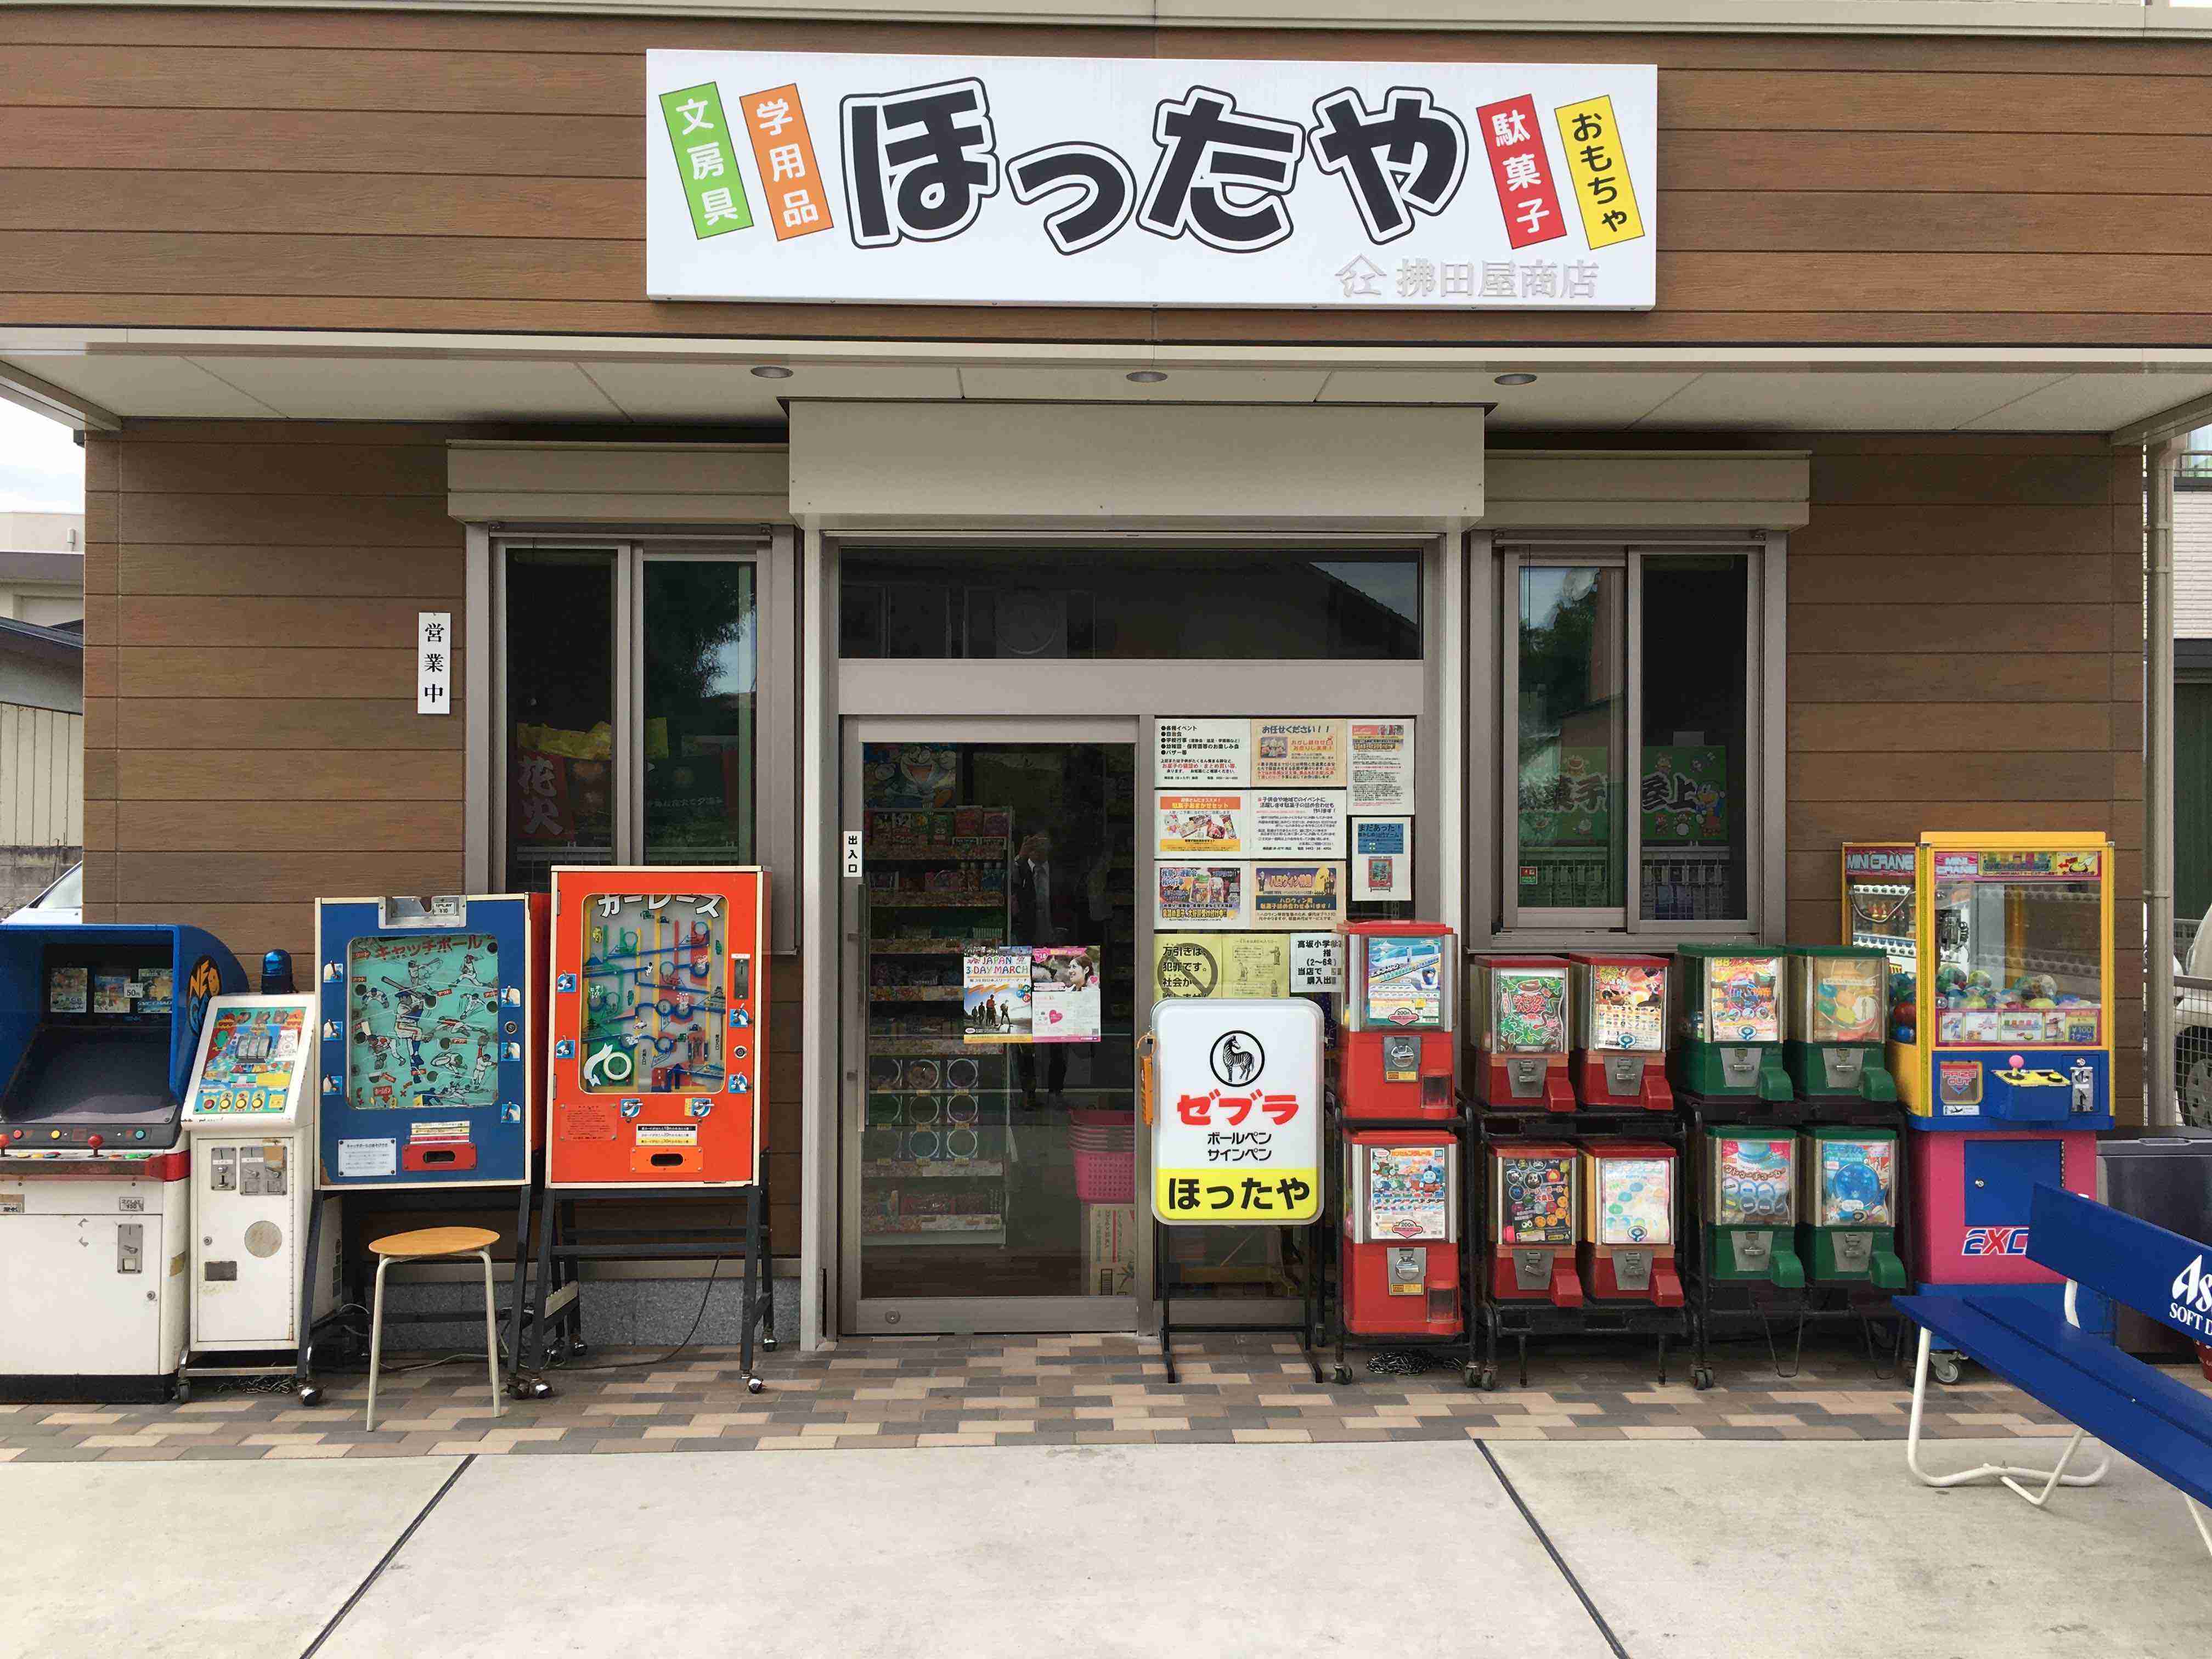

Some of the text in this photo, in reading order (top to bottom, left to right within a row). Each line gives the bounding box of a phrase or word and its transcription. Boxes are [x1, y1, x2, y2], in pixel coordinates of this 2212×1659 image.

[675, 98, 739, 227] 文房具
[757, 98, 820, 228] 学用品
[838, 78, 1468, 255] ほったや
[1490, 111, 1553, 234] 駄菓子
[1570, 110, 1630, 233] おもちゃ
[425, 623, 445, 703] 営業中
[848, 835, 857, 874] 出入口
[598, 895, 726, 918] カーレース
[375, 935, 483, 960] キャッチボール
[982, 956, 1012, 964] JAPAN
[1163, 946, 1208, 957] 万引きは、
[994, 966, 1028, 974] MARCH
[1163, 962, 1207, 972] 犯罪です。
[1177, 1088, 1299, 1126] ゼブラ
[1207, 1132, 1272, 1145] ボールペン
[1207, 1148, 1272, 1161] サインペン
[1169, 1177, 1310, 1210] ほったや
[1962, 1228, 2029, 1256] EXC
[2172, 1254, 2212, 1312] As
[2169, 1302, 2203, 1330] SOFT
